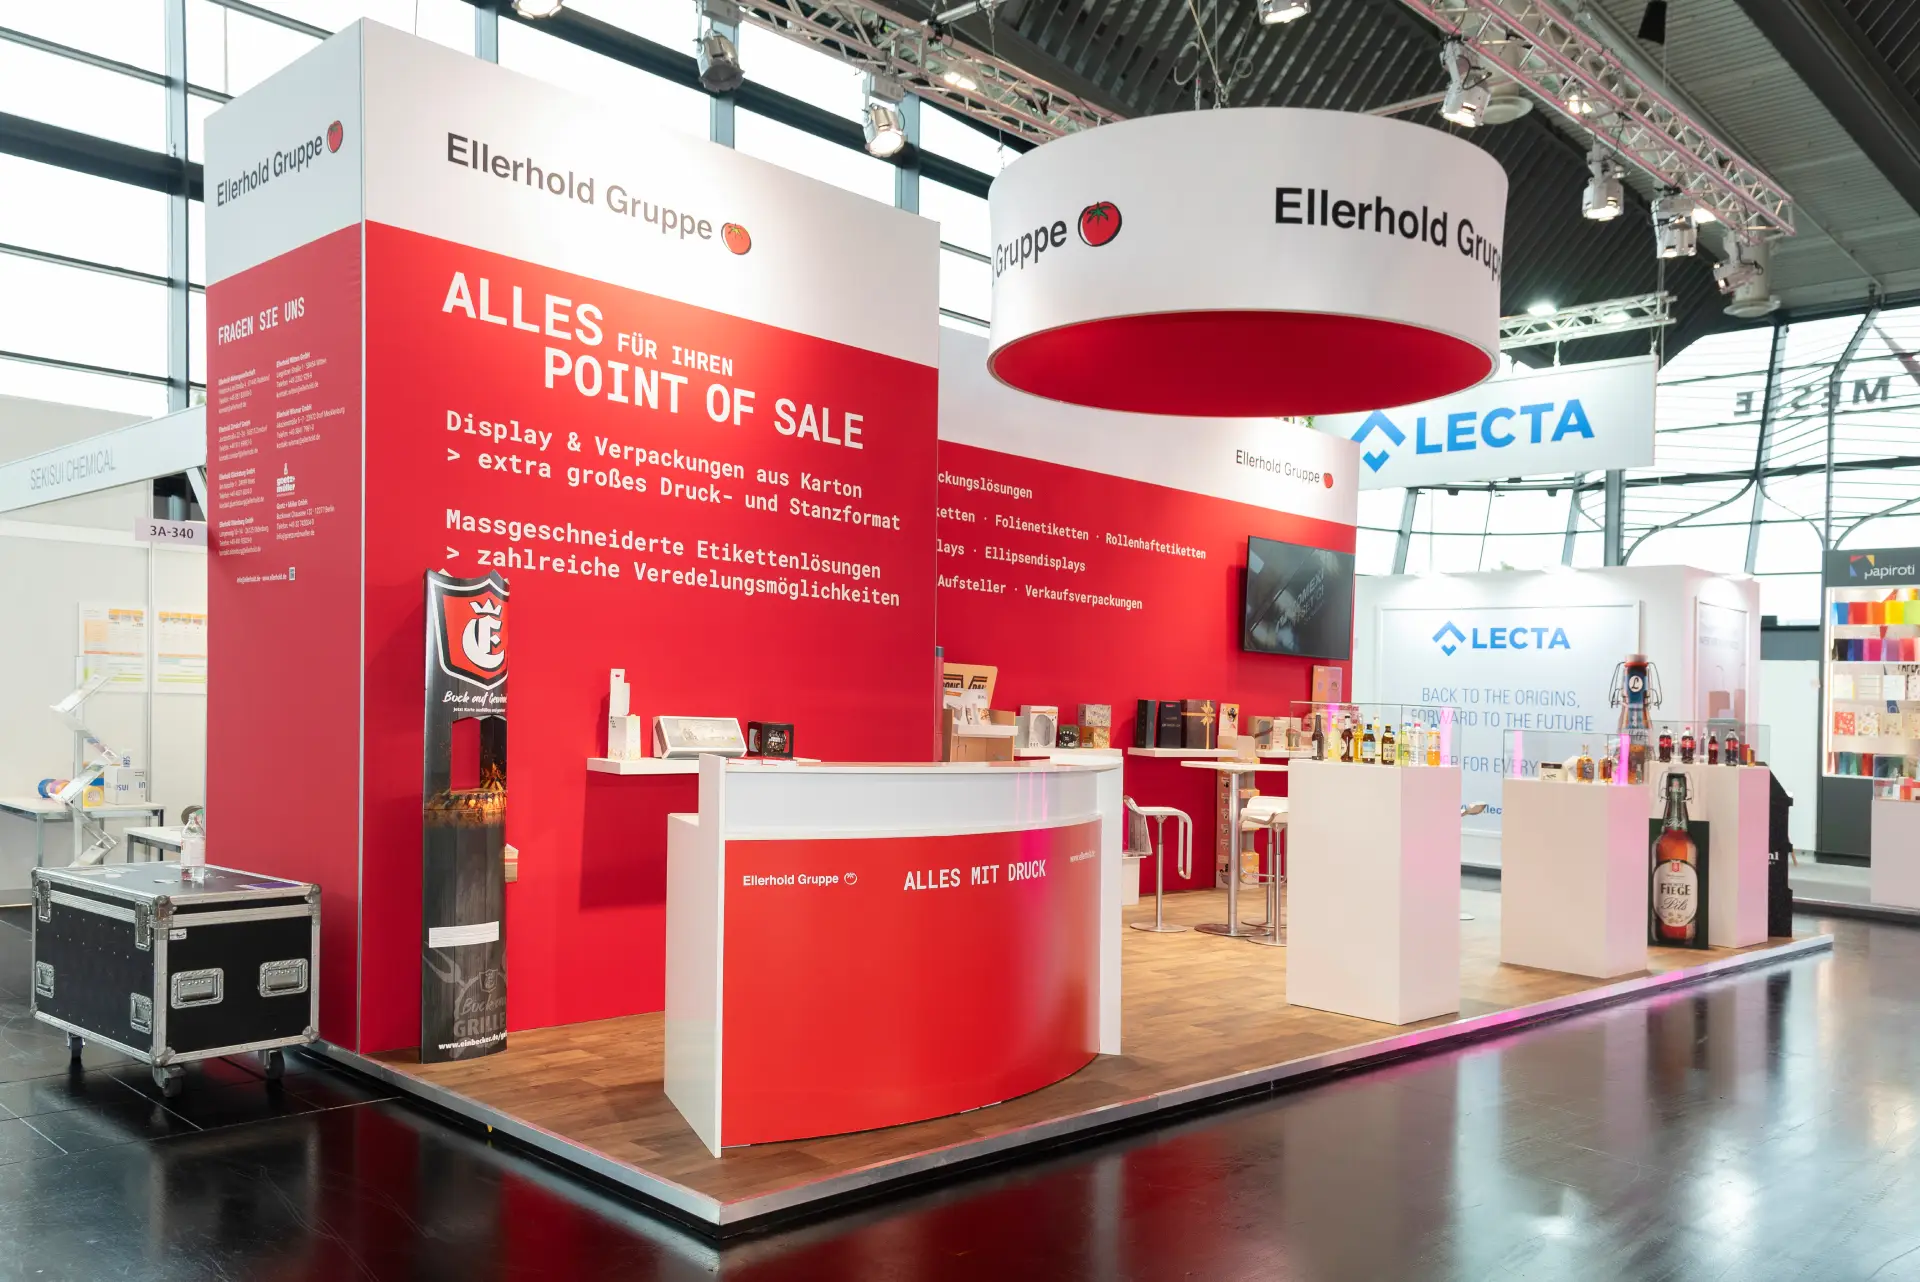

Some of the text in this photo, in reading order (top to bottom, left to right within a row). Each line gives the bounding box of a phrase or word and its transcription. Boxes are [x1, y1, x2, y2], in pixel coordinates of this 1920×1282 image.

[216, 133, 323, 208] Ellerhold Gruppe
[447, 132, 713, 242] Ellerhold Gruppe
[1275, 187, 1448, 247] Ellerhold
[996, 220, 1067, 278] Gruppe
[218, 296, 305, 347] FRAGEN SIE UNS
[442, 271, 603, 346] ALLES
[618, 332, 734, 376] FÜR IHREN
[544, 347, 865, 450] POINT OF SALE
[1415, 398, 1595, 455] LECTA
[30, 449, 117, 490] SEKISUI CHEMICAL
[447, 410, 863, 499] Display & Verpackungen aus Karton
[1236, 449, 1320, 485] Ellerhold Gruppe
[478, 448, 551, 479] extra
[567, 464, 647, 494] großes
[660, 478, 733, 504] Druck-
[745, 493, 778, 513] und
[789, 496, 901, 531] Stanzformat
[150, 526, 194, 539] 3A-340
[446, 508, 881, 580] Massgeschneiderte Etikettenlösungen
[936, 506, 1207, 560] etten Folienetiketten Rollenhaftetiketten
[477, 546, 620, 580] zahlreiche
[634, 561, 901, 607] Veredelungsmöglichkeiten
[985, 546, 1086, 572] Ellipsendisplays
[1864, 564, 1915, 580] papiroti
[938, 574, 1143, 611] Aufsteller Verkaufsverpackungen
[1472, 628, 1571, 649] LECTA
[1422, 687, 1580, 708] BACK TO THE ORIGINS,
[1412, 709, 1594, 731] FORWARD TO THE FUTURE
[1463, 756, 1489, 772] FOR
[1494, 758, 1538, 776] EVERY
[743, 873, 839, 887] Ellerhold Gruppe
[904, 860, 1046, 891] ALLES MIT DRUCK
[1663, 897, 1688, 911] Pils
